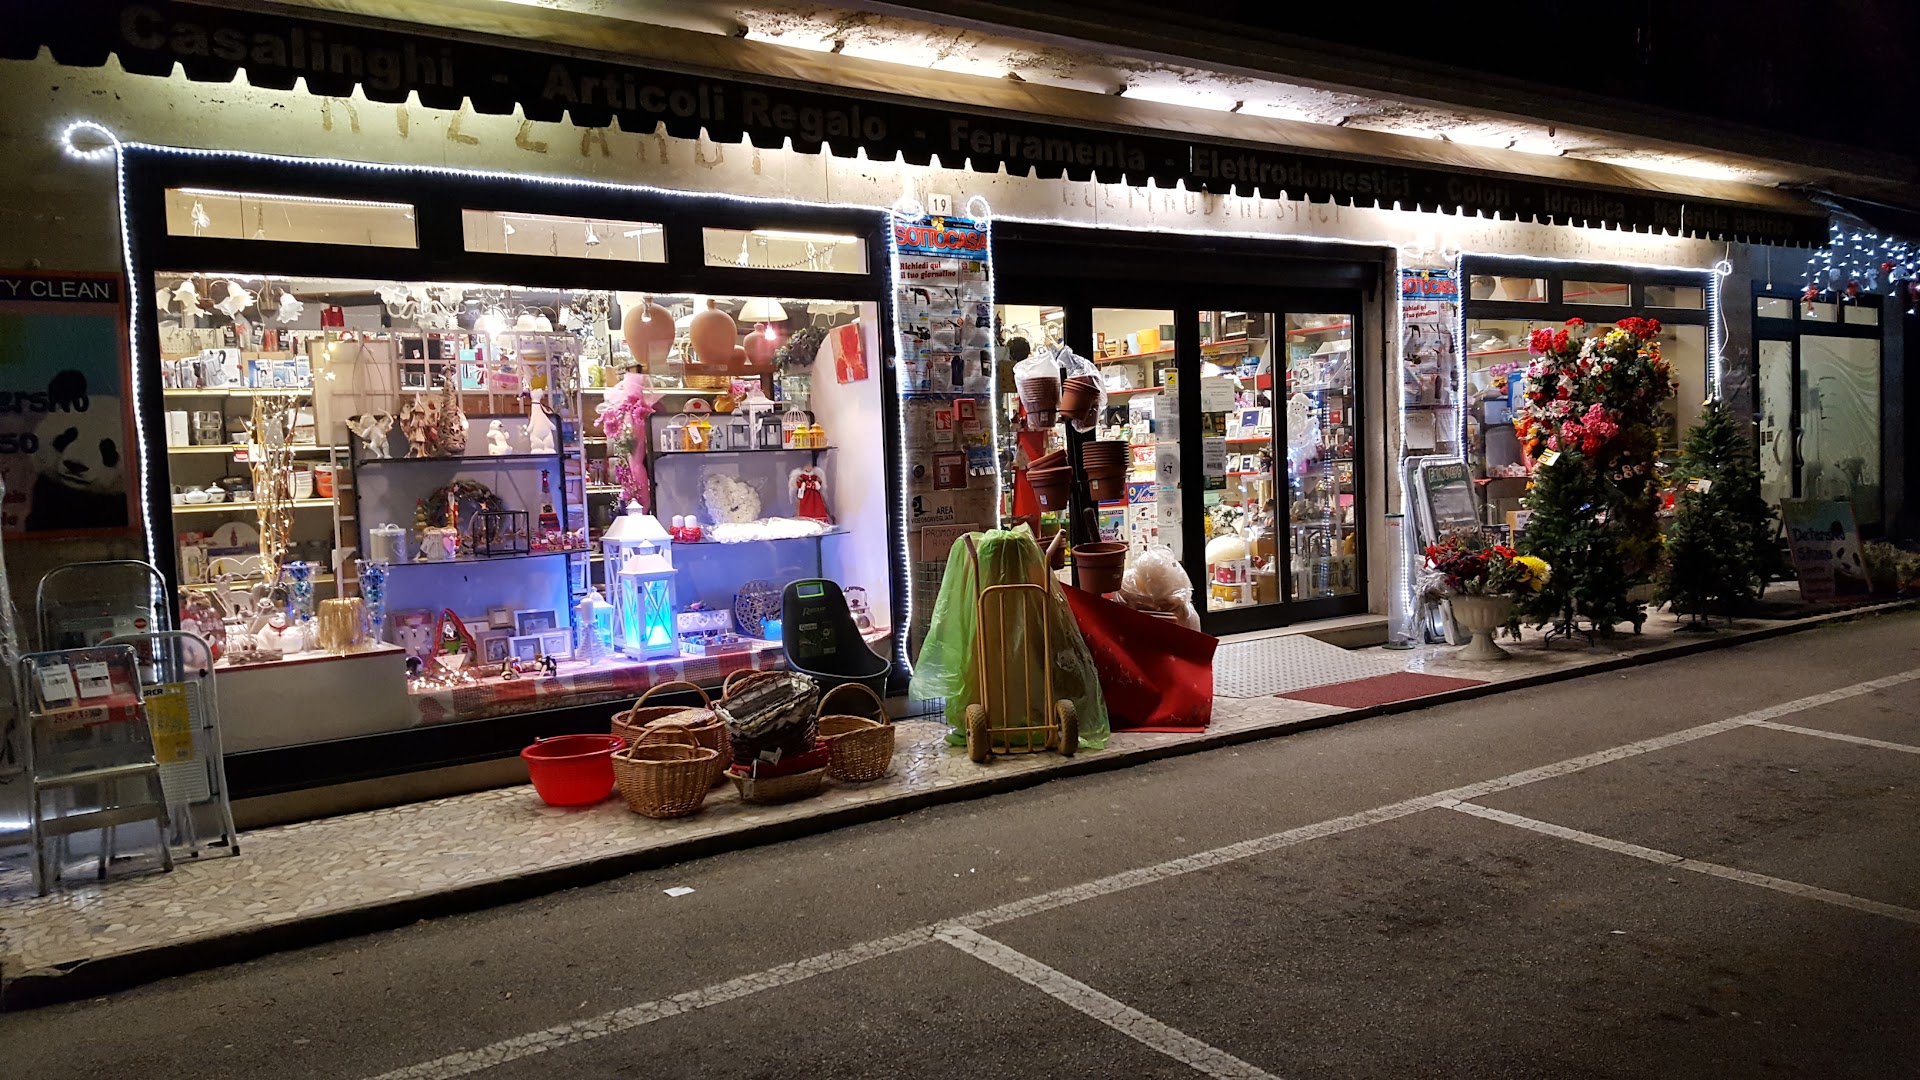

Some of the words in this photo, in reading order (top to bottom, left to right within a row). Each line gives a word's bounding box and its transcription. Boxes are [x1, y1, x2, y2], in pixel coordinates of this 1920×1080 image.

[120, 4, 455, 90] Casalinghi
[541, 64, 726, 121] Articoli
[743, 90, 887, 142] Regalo
[949, 117, 1146, 171] Ferramenta
[1192, 149, 1413, 197] Elettrodomestici
[1447, 178, 1512, 206] Colori
[1544, 188, 1626, 219] Idraulica
[1653, 201, 1729, 229] Maeriale
[933, 198, 947, 211] 19
[895, 225, 988, 251] SOTTOCASA
[900, 261, 929, 270] Richiedi
[929, 261, 942, 270] qui
[907, 271, 919, 279] tuo
[920, 270, 956, 280] giornalino
[30, 280, 110, 299] CLEAN
[936, 505, 954, 515] AREA
[911, 515, 954, 524] VIDEOSORVEGLIATA
[925, 527, 971, 538] PROMOZION
